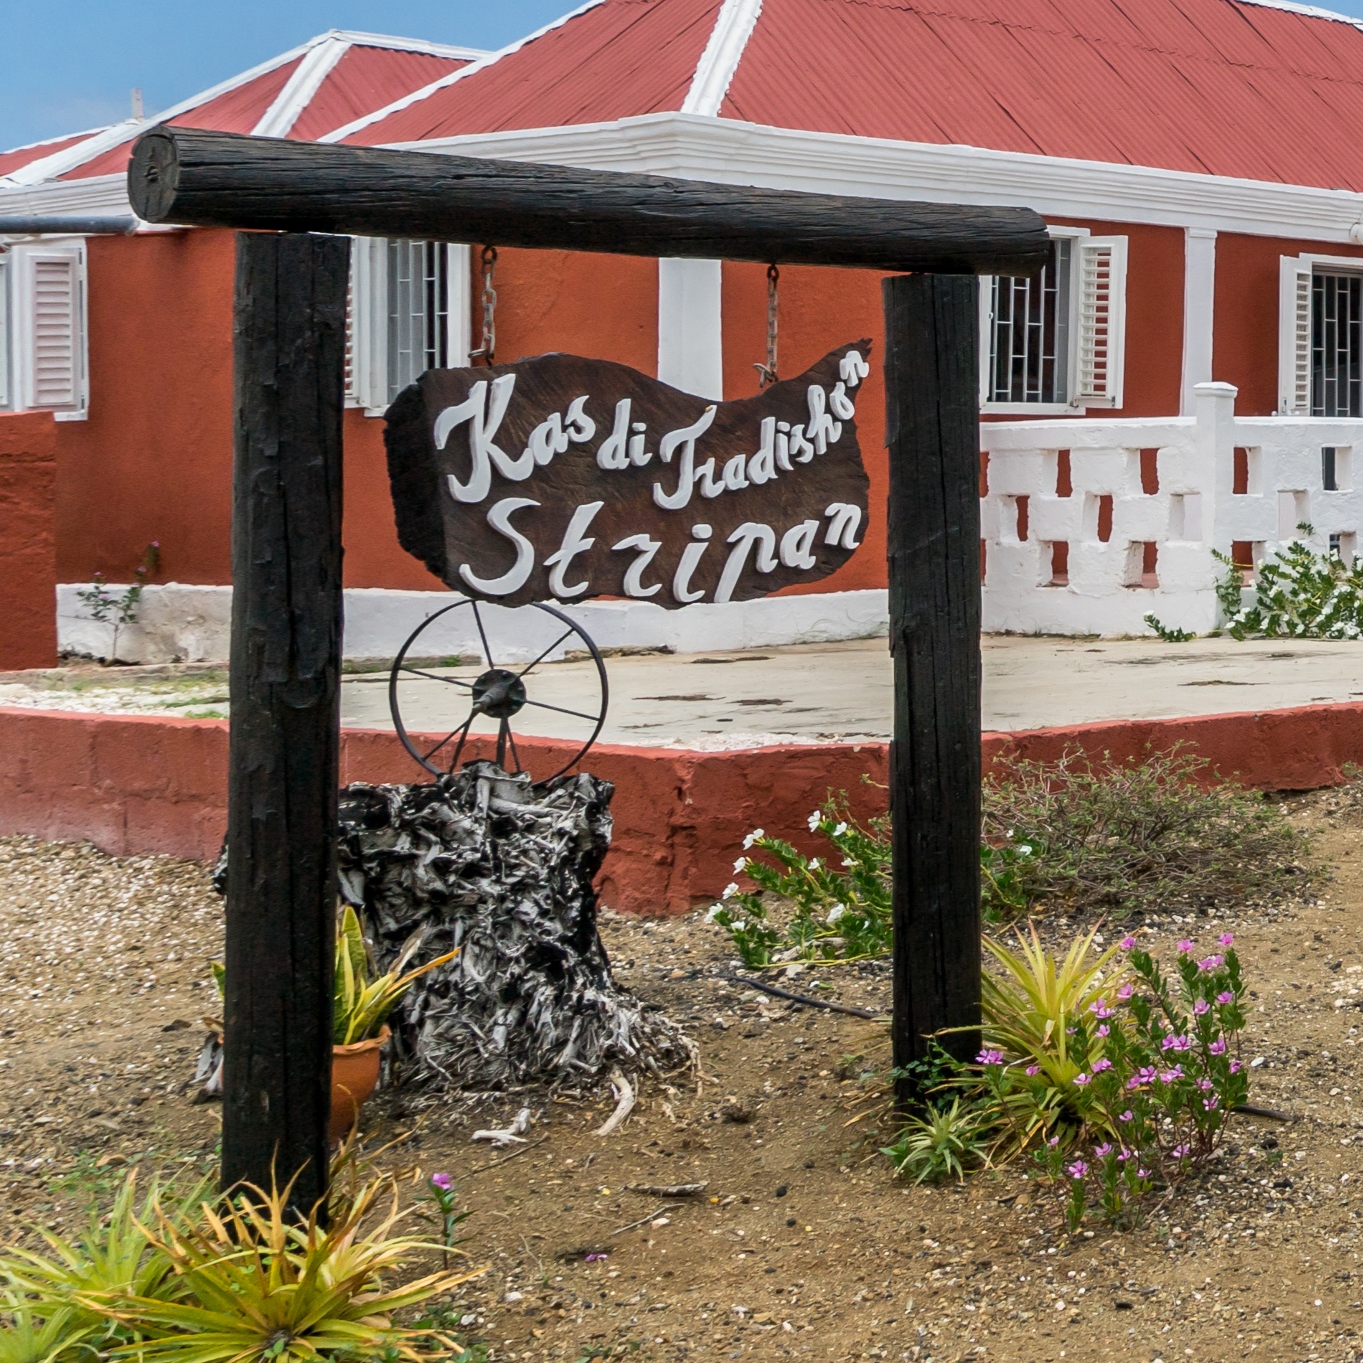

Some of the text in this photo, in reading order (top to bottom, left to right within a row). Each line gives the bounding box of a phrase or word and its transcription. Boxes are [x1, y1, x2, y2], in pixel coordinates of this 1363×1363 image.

[434, 350, 870, 510] Kas di Tradishon
[458, 497, 863, 604] Stripan
